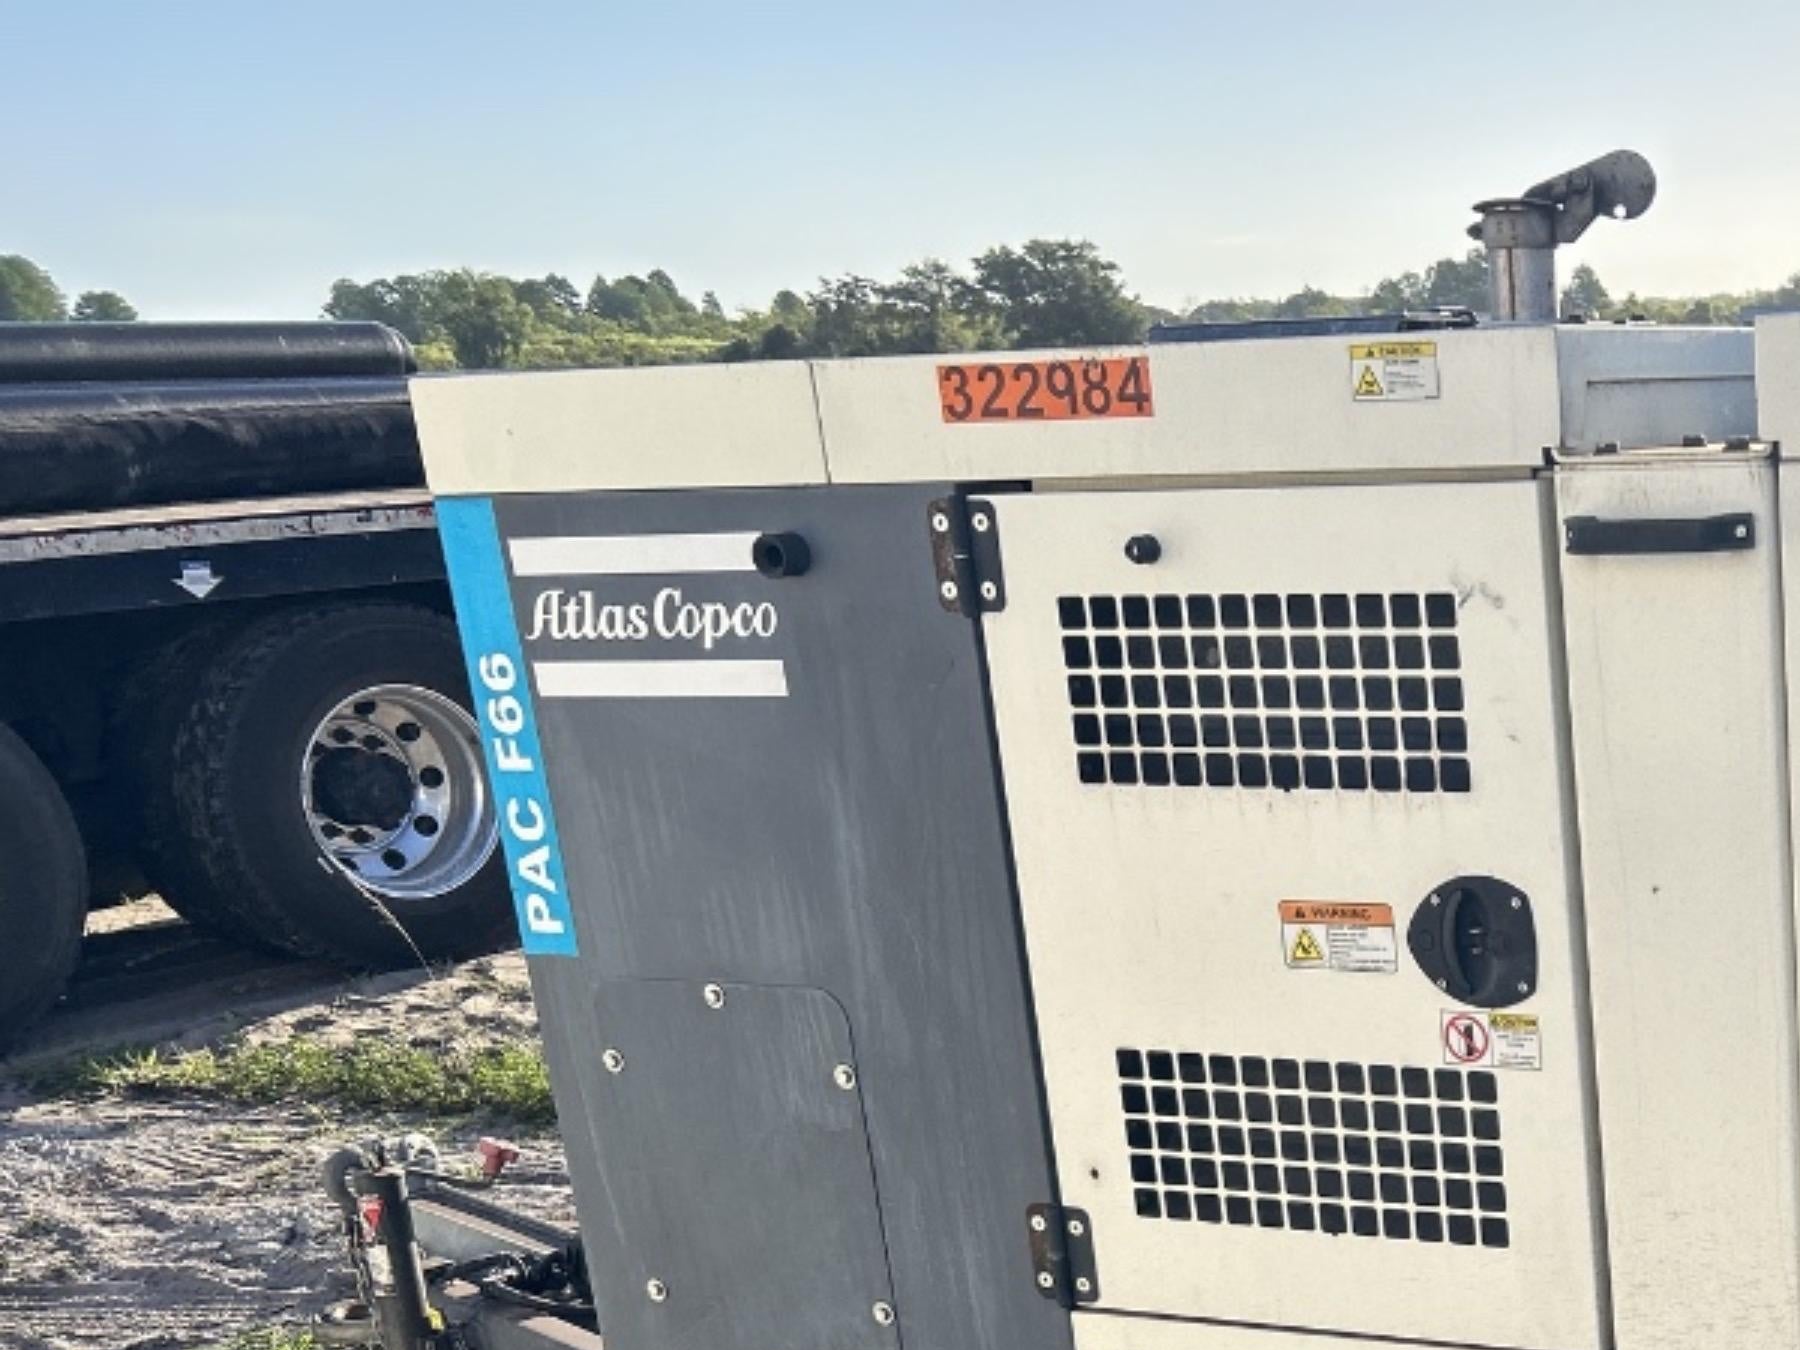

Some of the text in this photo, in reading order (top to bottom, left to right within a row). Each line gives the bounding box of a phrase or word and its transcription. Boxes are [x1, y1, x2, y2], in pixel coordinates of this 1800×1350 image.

[943, 357, 1150, 420] 322984
[525, 586, 778, 650] Atlas Copco
[478, 653, 565, 935] PAC F66
